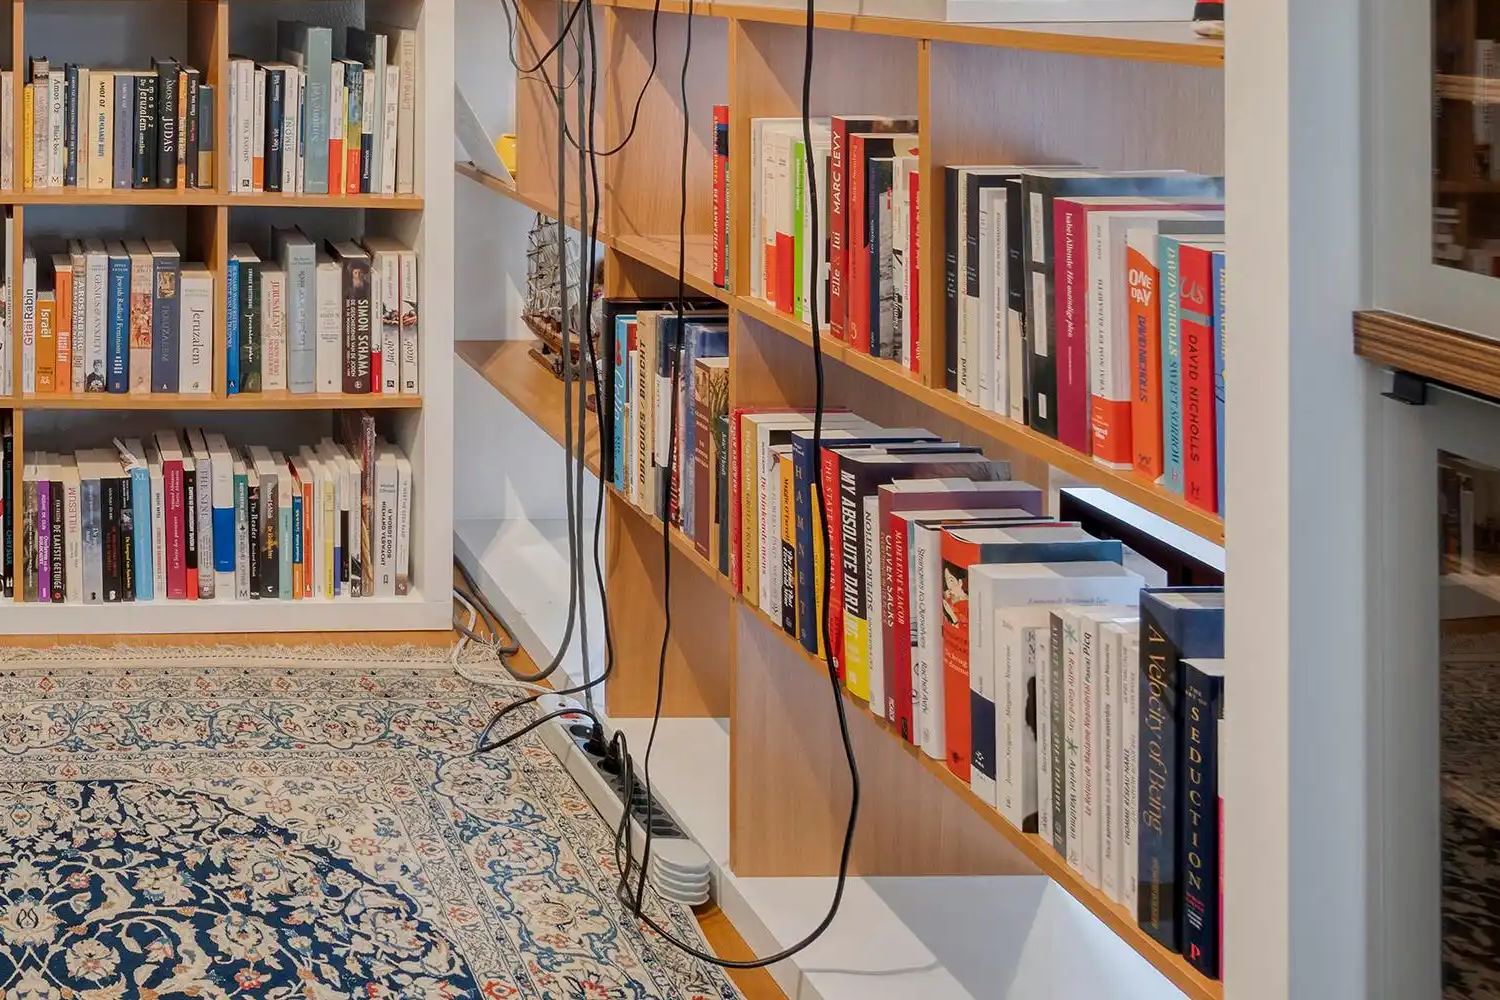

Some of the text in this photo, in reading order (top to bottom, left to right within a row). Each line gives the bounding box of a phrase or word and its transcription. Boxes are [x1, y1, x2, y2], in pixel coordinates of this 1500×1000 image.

[54, 103, 60, 114] Oz
[138, 87, 149, 131] Jeruzalem
[140, 79, 146, 87] De
[165, 101, 172, 112] OZ
[162, 116, 173, 152] JUDAS
[284, 116, 292, 151] SIMONE
[310, 82, 320, 141] Simone Veil
[832, 131, 841, 214] MARC LEVY
[1065, 212, 1074, 236] Isabel
[1065, 237, 1074, 268] Allende
[271, 280, 280, 328] JERUSALEM
[1065, 285, 1073, 319] oneindige
[1129, 269, 1152, 289] ONE
[1130, 287, 1151, 306] DAY
[41, 308, 51, 338] Israël
[115, 275, 124, 354] Jewish Radical Feminism
[161, 305, 169, 361] JERUZALEM
[190, 308, 204, 365] Jeruzalem
[357, 299, 368, 376] SIMON SCHAMA
[1065, 321, 1073, 338] plan
[1137, 315, 1147, 402] DAVID NICHOLLS
[1167, 248, 1180, 463] DAVID NICHOLLS SWEET SORROW
[1188, 334, 1201, 461] DAVID NICHOLLS
[824, 459, 832, 482] THE
[68, 487, 76, 533] HILLESUM
[783, 505, 791, 541] O'Farrell
[826, 486, 834, 519] STATE
[53, 524, 61, 589] DE LAATSTE GETUIGE
[795, 467, 806, 608] HAMNET
[840, 471, 860, 637] MY ABSOLUTE DARLING
[865, 511, 873, 611] SUPERPOSITION
[886, 535, 895, 627] OLIVER SACKS
[917, 547, 929, 714] Strangers to Ourselves Rachel Aviv
[1067, 648, 1077, 839] A Really Good Day Ayelet Waldman
[1143, 625, 1168, 837] A Velocity of Being
[1188, 707, 1202, 890] SEDUCTION
